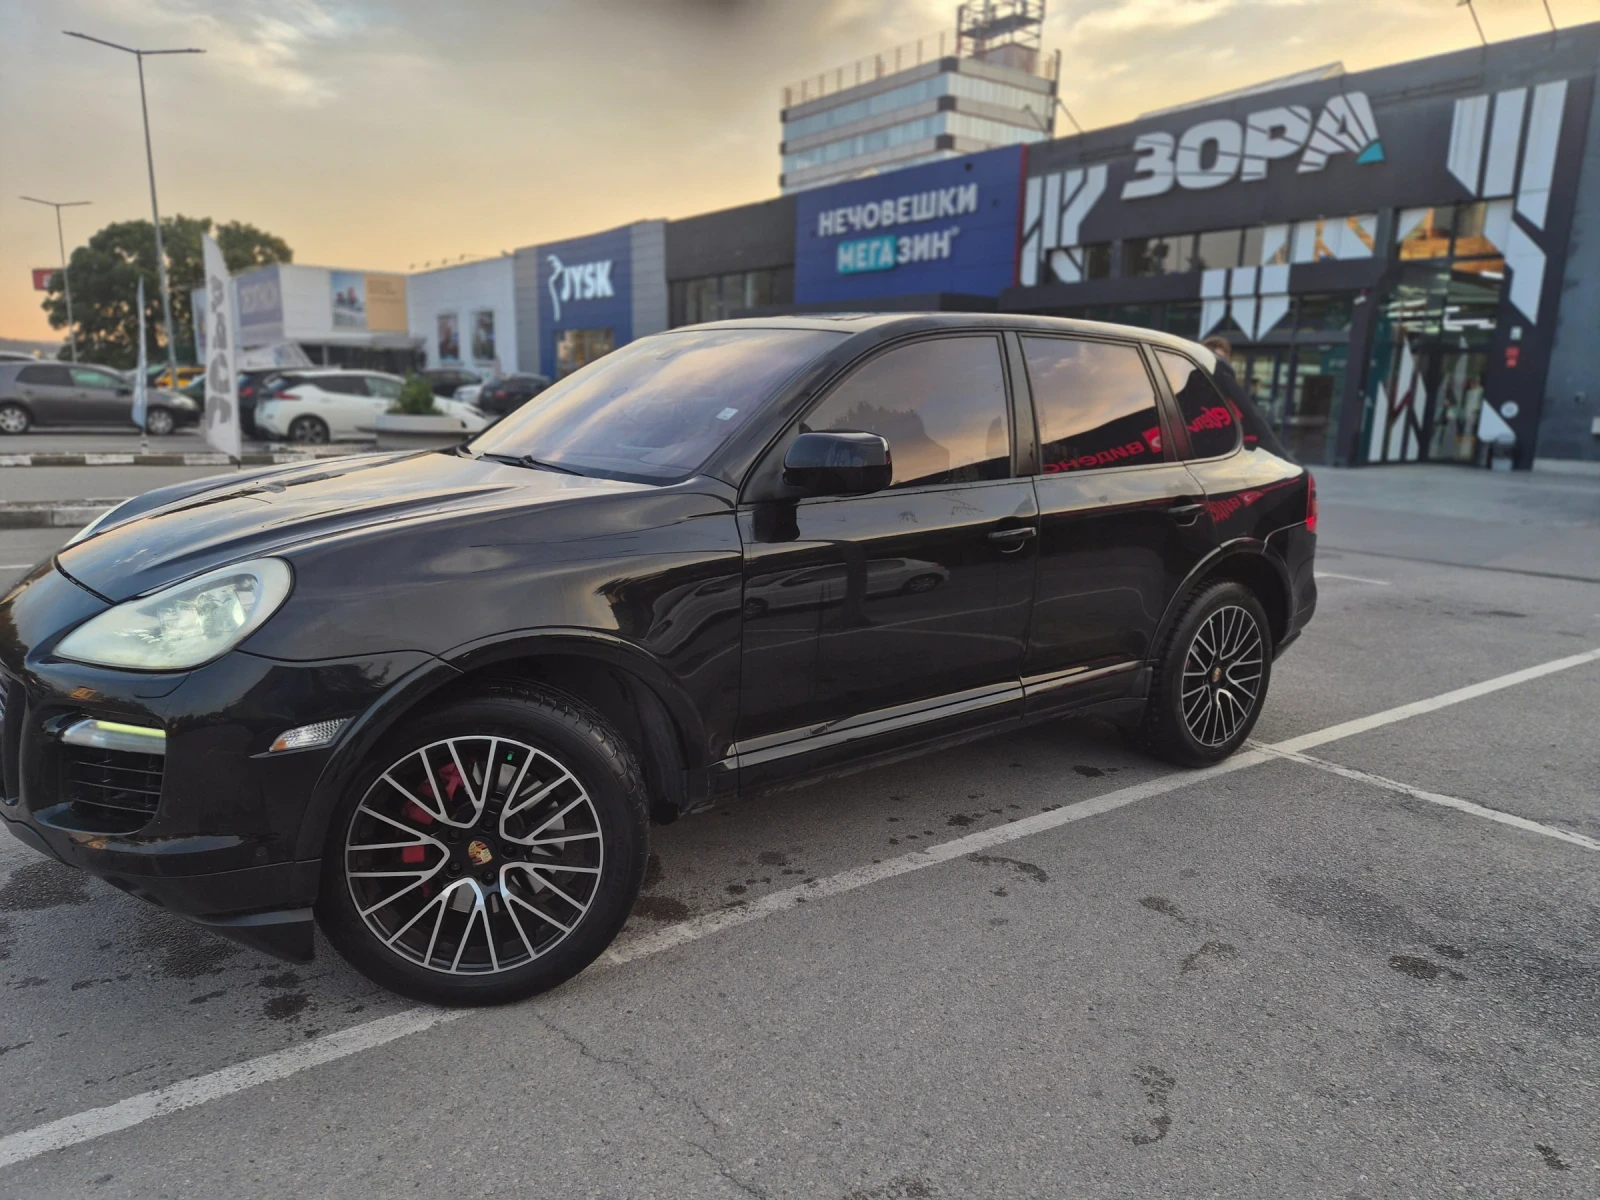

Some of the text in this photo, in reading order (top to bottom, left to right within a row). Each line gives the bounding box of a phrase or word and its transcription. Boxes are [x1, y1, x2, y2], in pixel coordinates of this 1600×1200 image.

[1121, 91, 1384, 199] ЗОРА
[818, 183, 978, 237] НЕЧОВЕШКИ
[561, 259, 615, 302] JYSK
